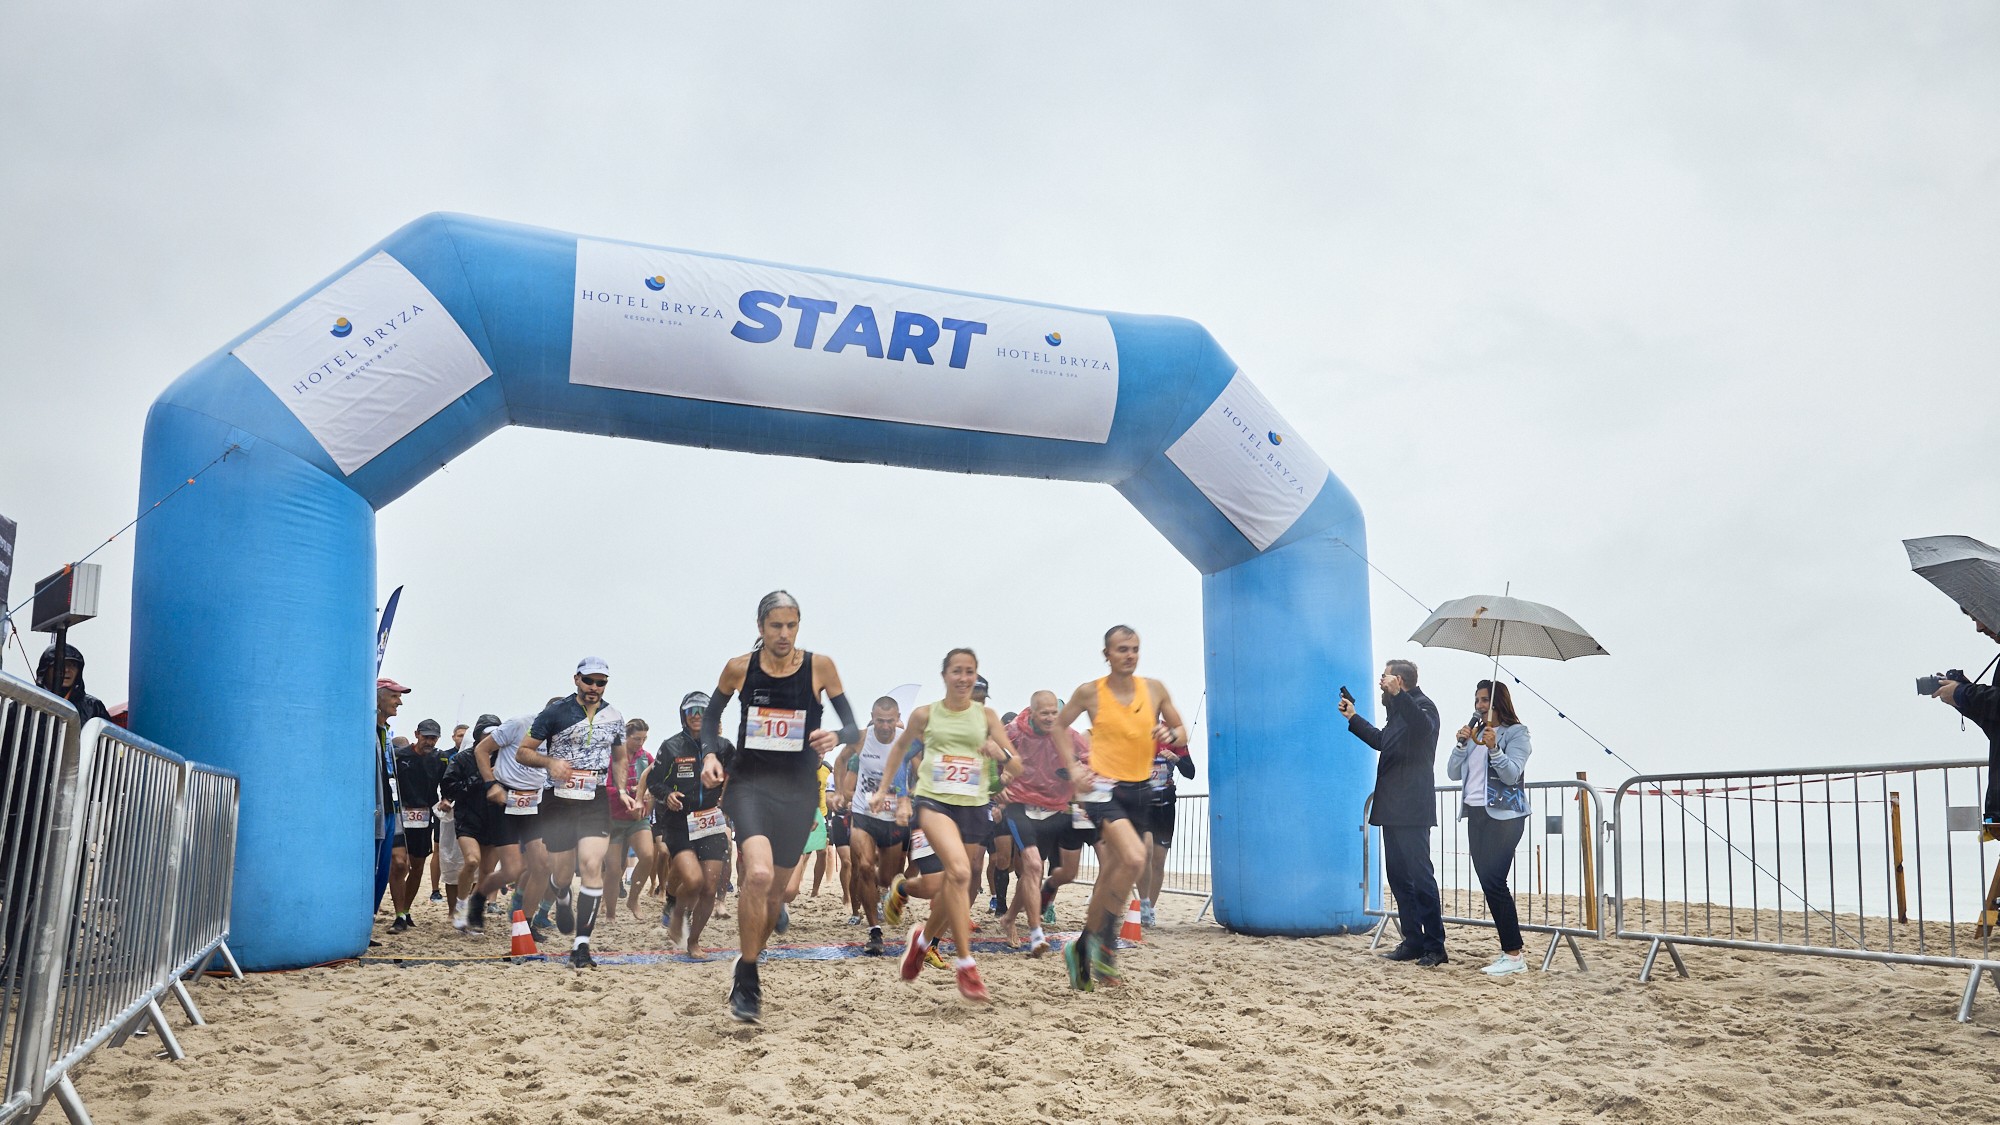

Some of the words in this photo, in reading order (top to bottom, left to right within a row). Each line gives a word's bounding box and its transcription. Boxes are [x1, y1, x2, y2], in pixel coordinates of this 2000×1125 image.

[581, 289, 649, 309] HOTEL
[661, 301, 724, 319] BRYZA
[624, 313, 656, 323] RESORT
[730, 289, 987, 370] START
[293, 349, 358, 394] HOTEL
[363, 304, 424, 347] BRYZA
[997, 347, 1051, 363] HOTEL
[1060, 355, 1111, 371] BRYZA
[345, 358, 375, 381] RESORT
[384, 343, 399, 354] SPA
[1223, 407, 1262, 450] HOTEL
[1267, 453, 1304, 494] BRYZA
[764, 719, 788, 738] 10
[566, 777, 585, 790] 51
[946, 765, 970, 783] 25
[408, 811, 423, 821] 36
[699, 815, 717, 829] 34
